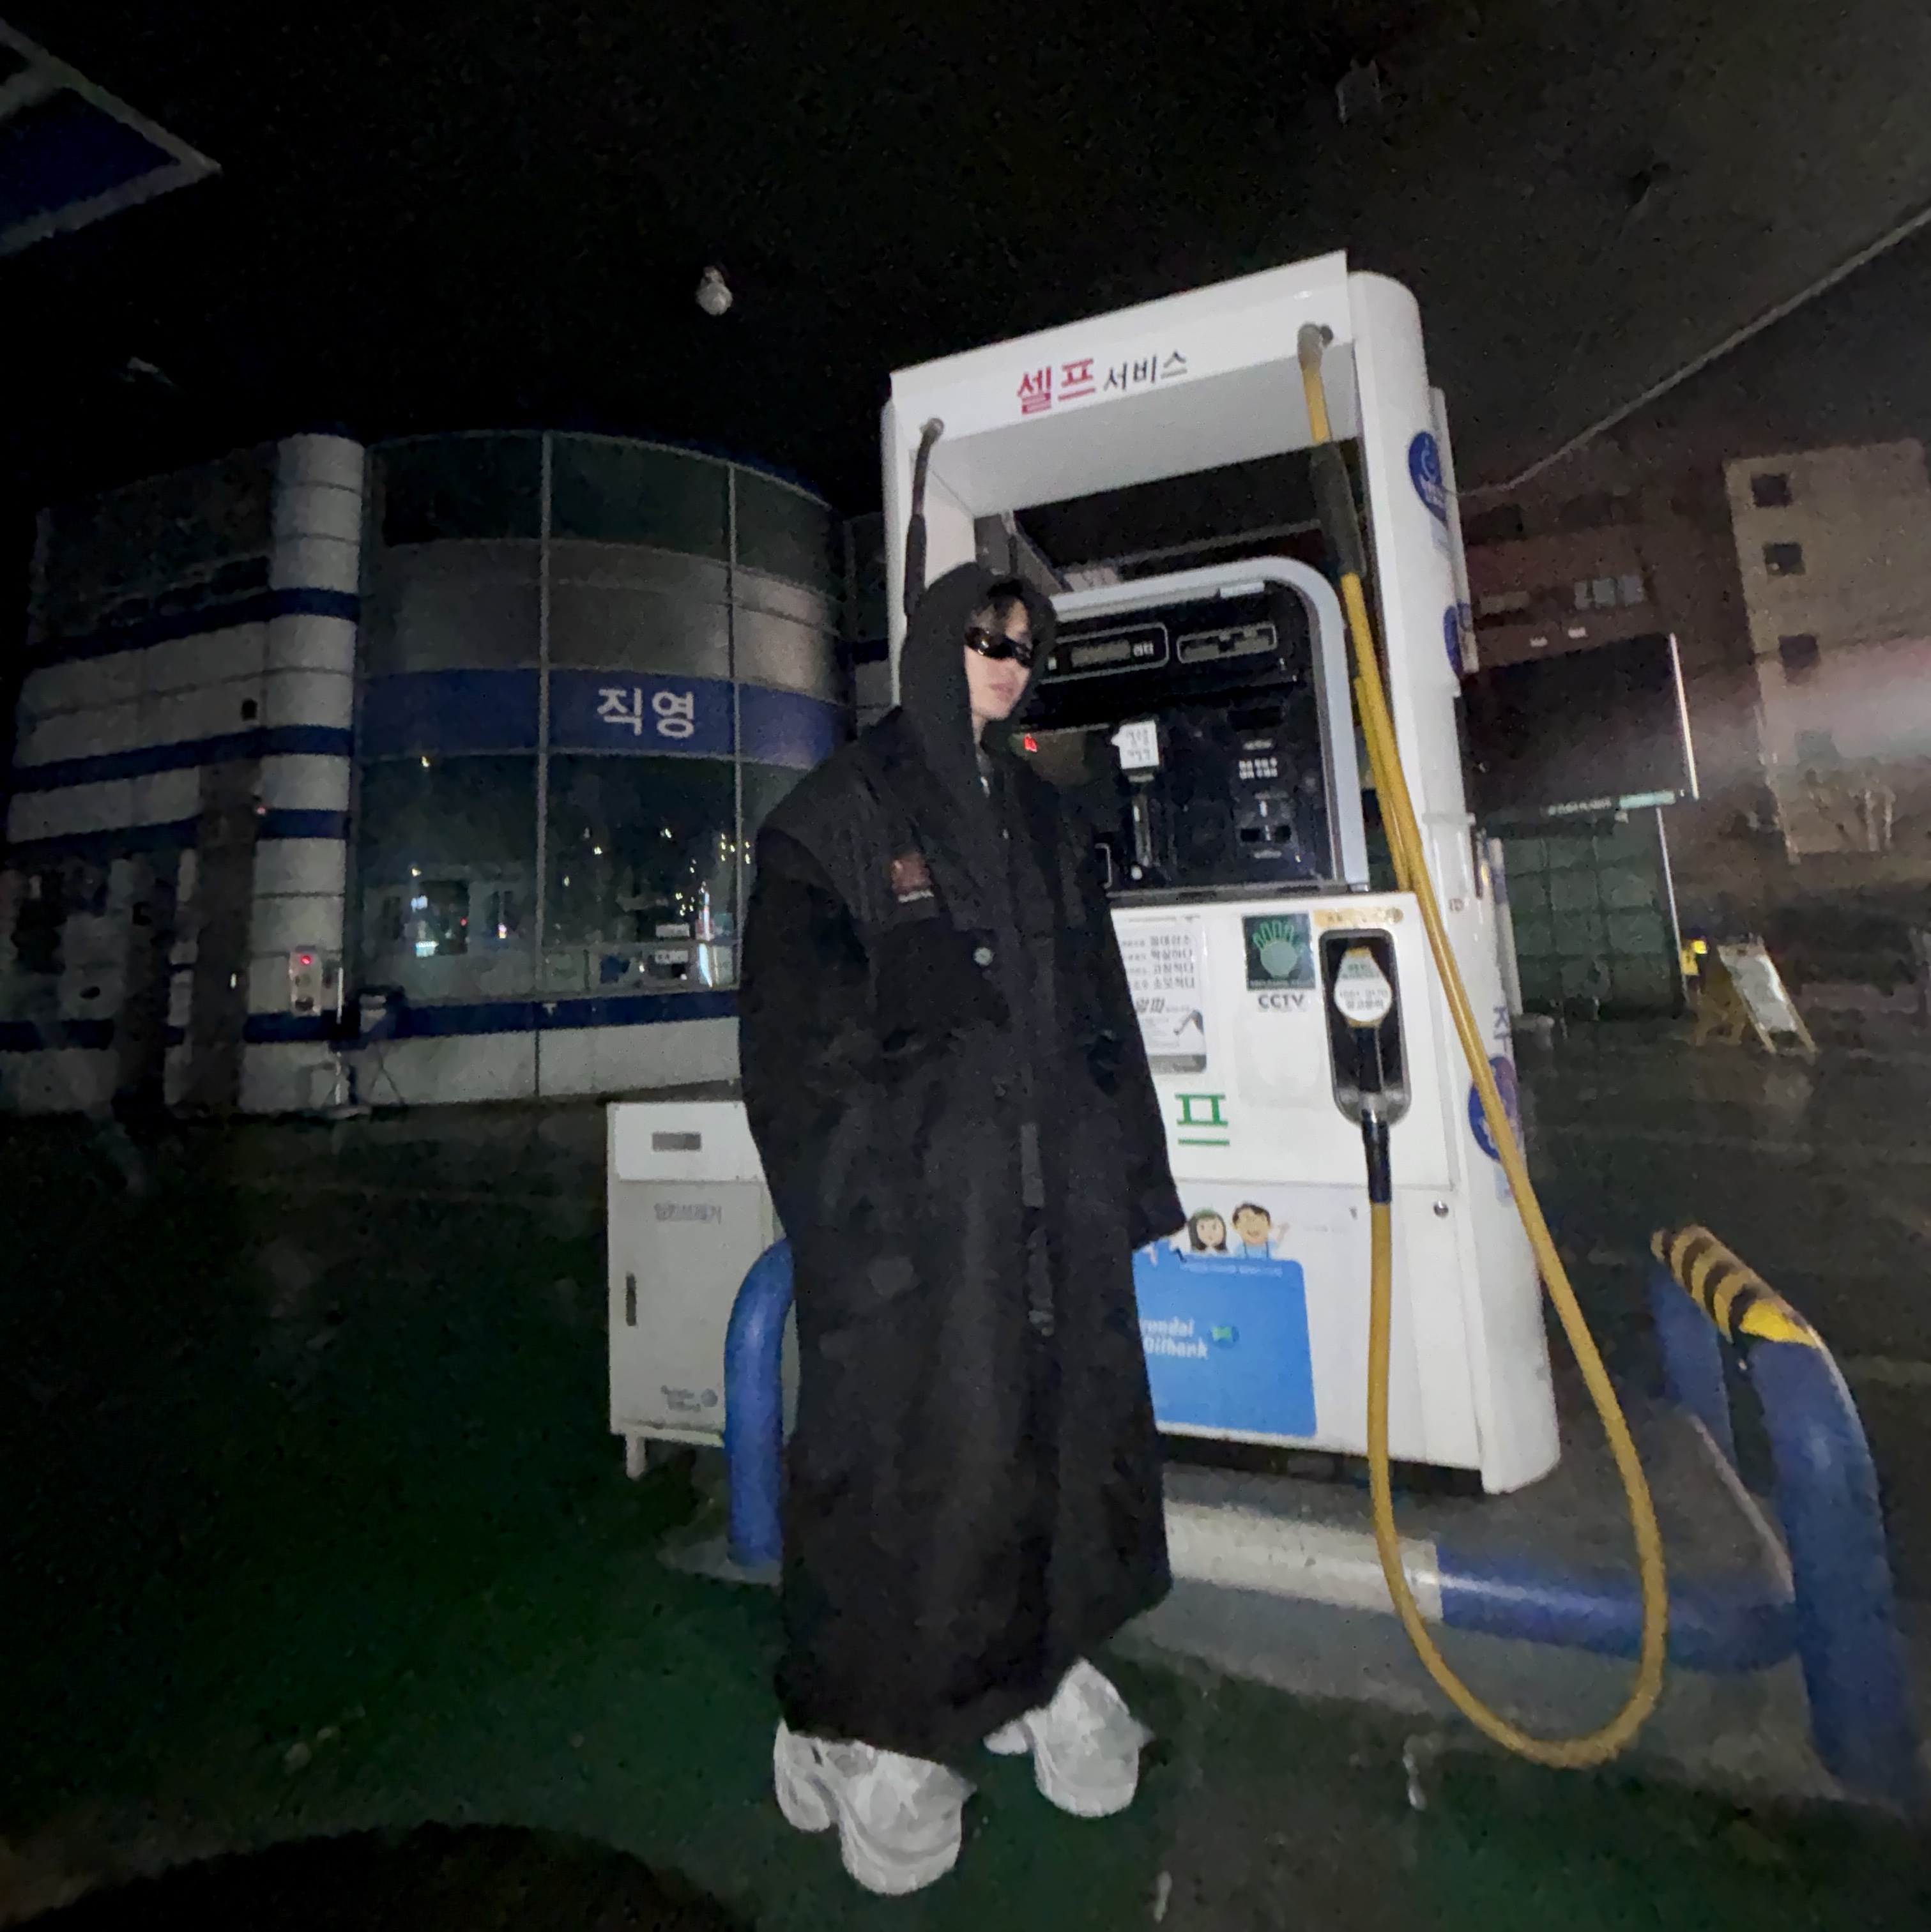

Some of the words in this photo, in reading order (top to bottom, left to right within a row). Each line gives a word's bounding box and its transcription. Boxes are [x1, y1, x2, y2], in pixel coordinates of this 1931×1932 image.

[1016, 358, 1096, 415] 셀프
[1103, 350, 1187, 391] 서비스
[597, 687, 695, 738] 직영
[1258, 994, 1304, 1009] CCTV
